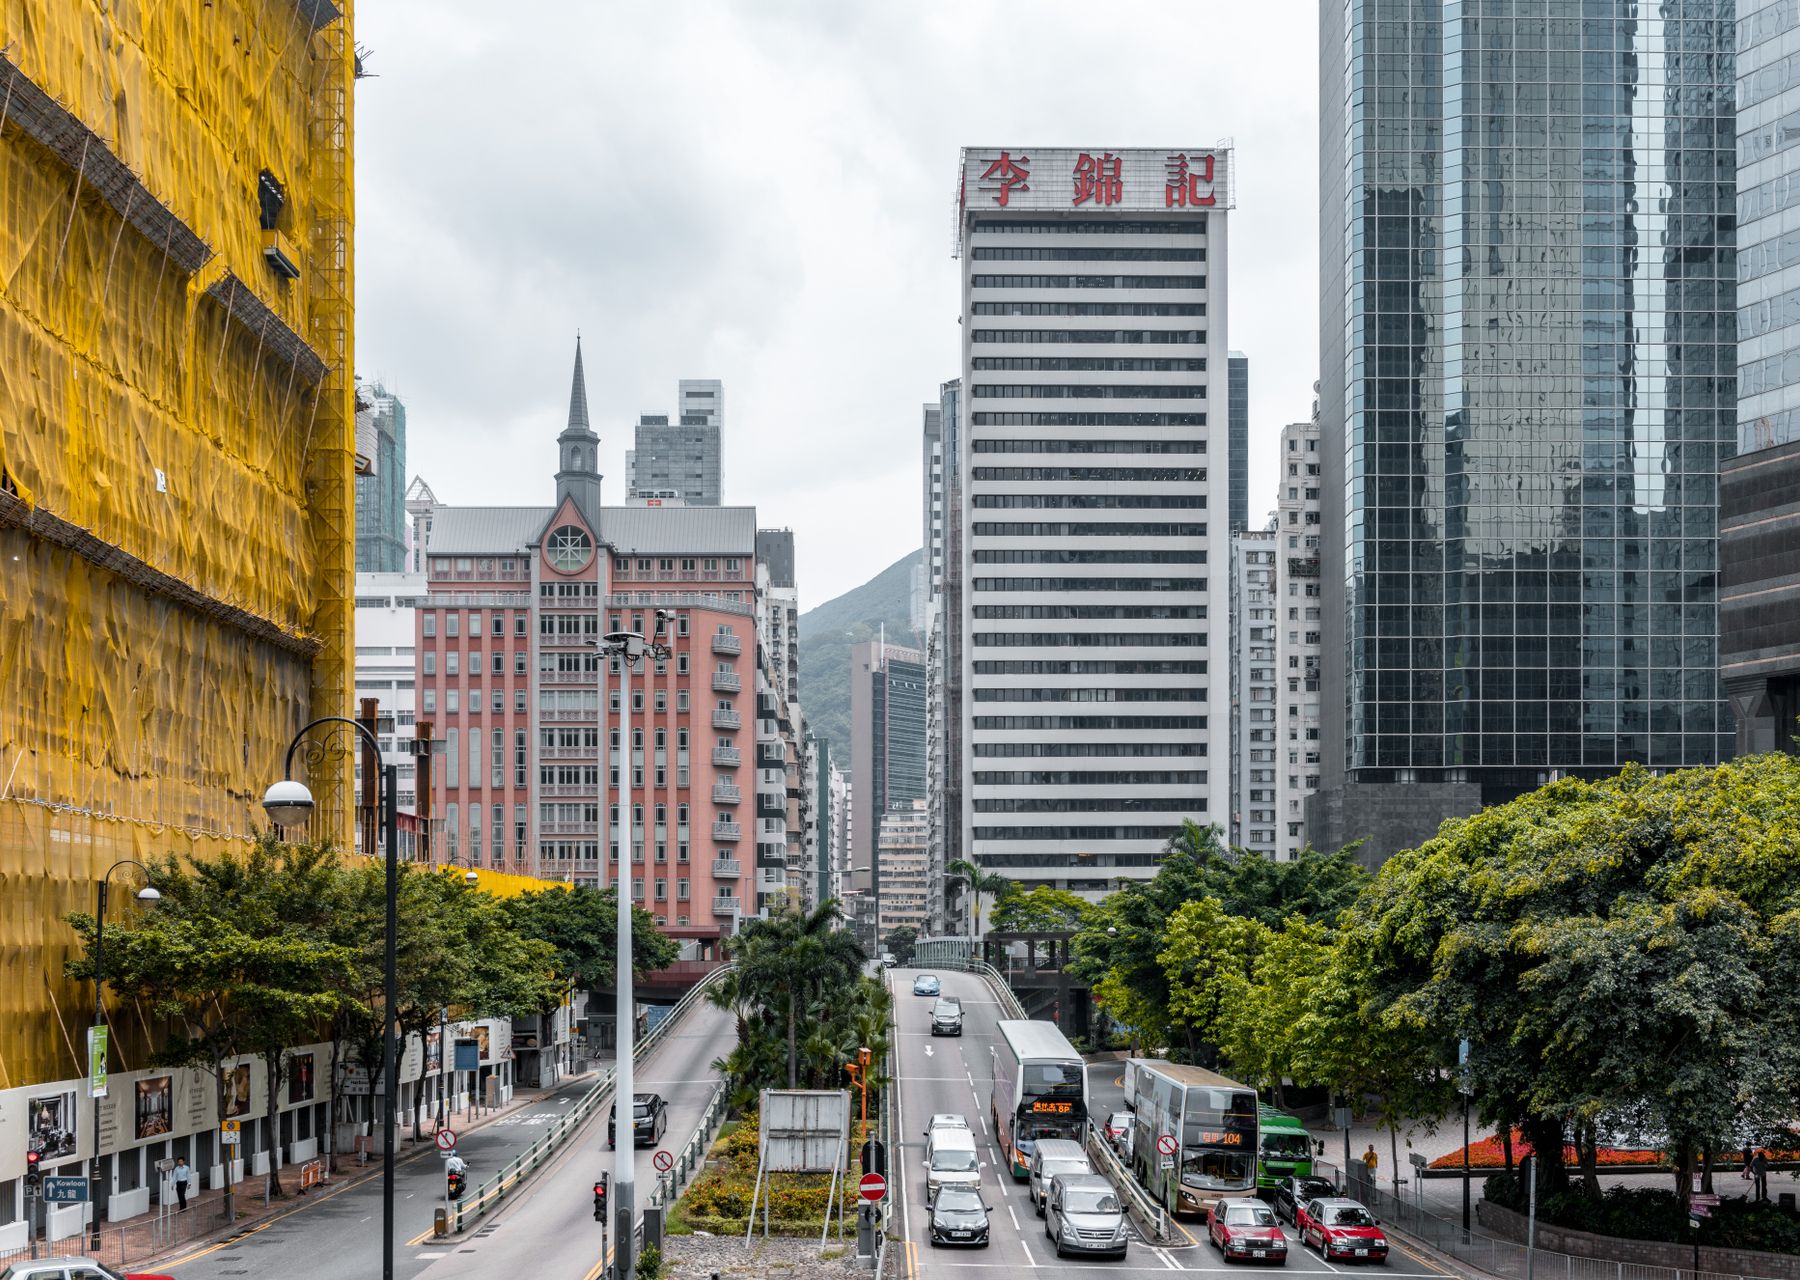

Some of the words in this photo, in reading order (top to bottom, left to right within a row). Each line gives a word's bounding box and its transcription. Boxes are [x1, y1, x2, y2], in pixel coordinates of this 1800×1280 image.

[978, 152, 1217, 207] 李錦記
[1223, 1133, 1241, 1145] 104
[57, 1189, 77, 1199] 九龍
